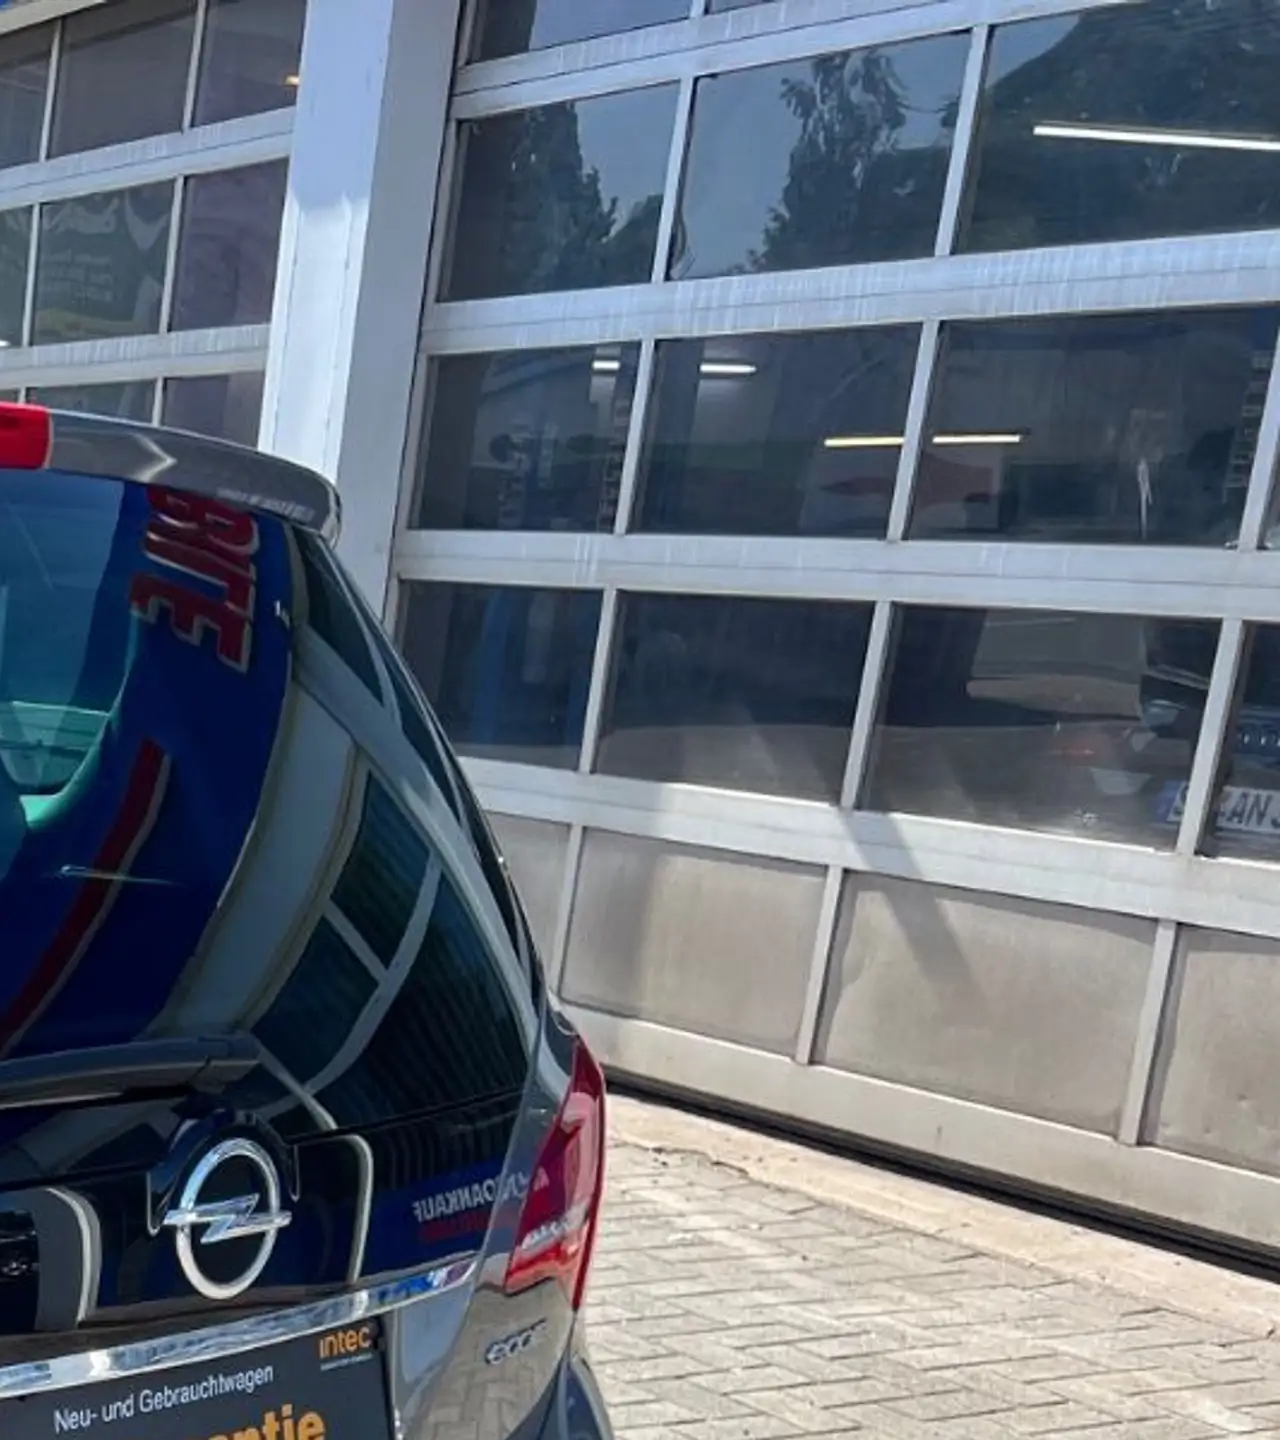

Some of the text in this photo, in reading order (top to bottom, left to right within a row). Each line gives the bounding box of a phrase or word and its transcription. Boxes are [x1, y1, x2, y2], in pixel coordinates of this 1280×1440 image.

[53, 1364, 274, 1435] Neu- und Gebrauchtwagen
